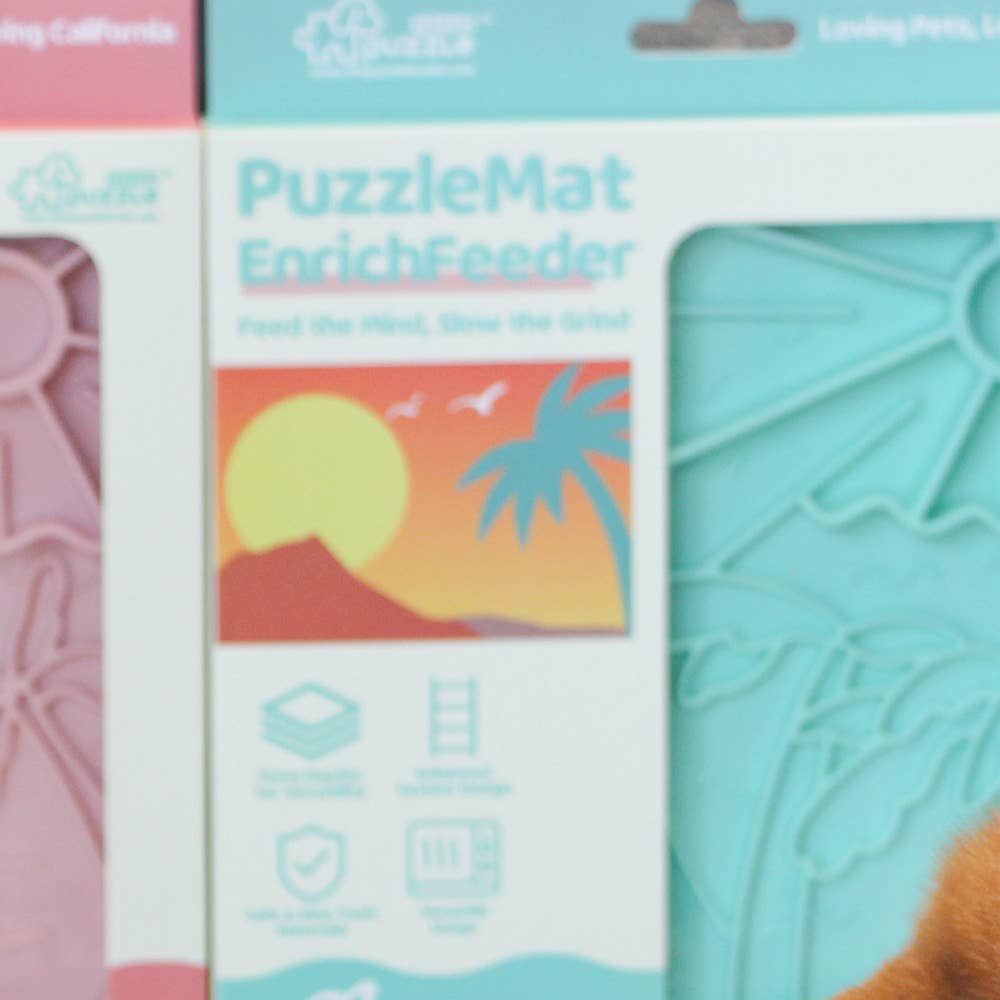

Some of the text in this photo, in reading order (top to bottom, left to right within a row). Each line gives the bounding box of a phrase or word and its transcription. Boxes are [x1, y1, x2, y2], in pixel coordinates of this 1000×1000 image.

[50, 17, 177, 45] California
[818, 13, 906, 45] Loving
[237, 152, 634, 216] PuzzleMat
[237, 231, 636, 286] EnrichFeeder
[237, 315, 302, 337] Feed
[310, 314, 354, 335] the
[509, 309, 553, 331] the
